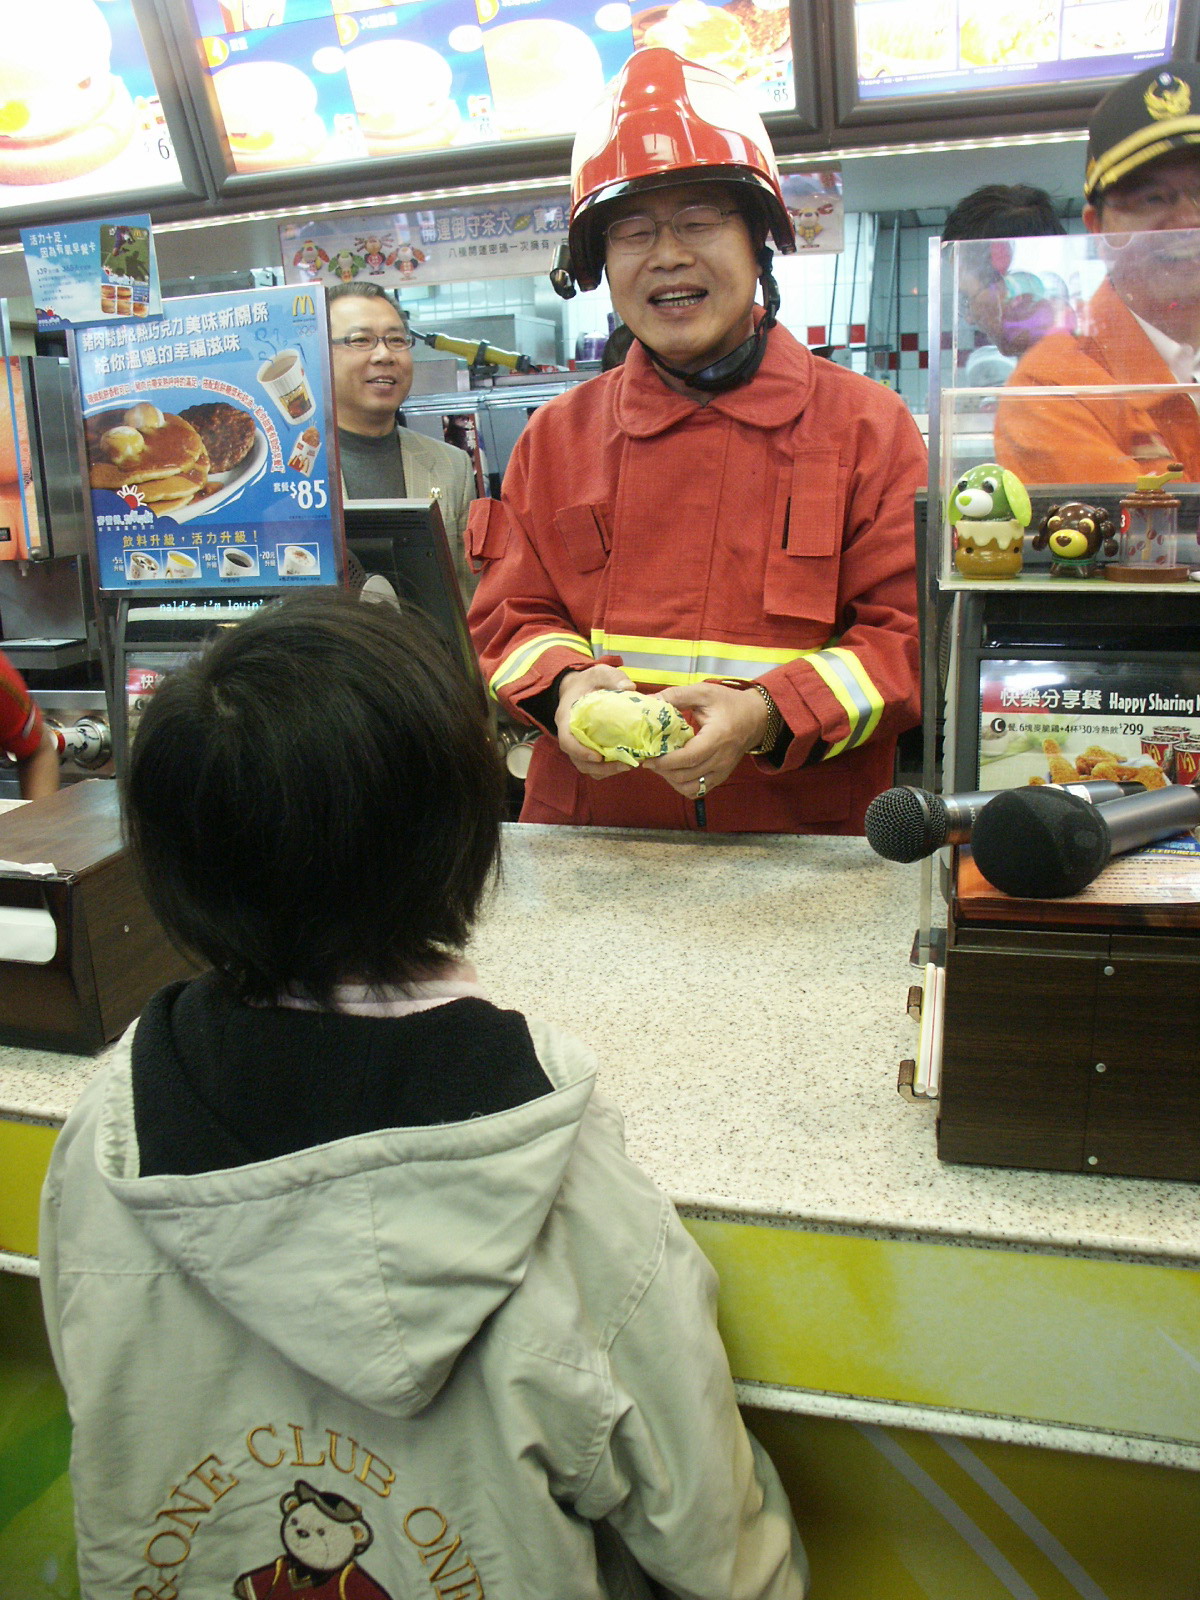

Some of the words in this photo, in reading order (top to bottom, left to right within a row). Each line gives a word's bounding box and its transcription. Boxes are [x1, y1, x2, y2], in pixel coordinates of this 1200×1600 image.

[94, 334, 241, 374] 給你溫暖的幸福滋味
[123, 529, 258, 548] 飲料升級，活力升級！
[203, 600, 221, 611] i'm
[1000, 688, 1102, 709] 快樂分享餐
[1109, 692, 1146, 713] Happy
[1148, 693, 1194, 714] Sharing
[144, 1454, 239, 1568] ONE
[247, 1423, 396, 1498] CLUB
[403, 1505, 485, 1600] ONE
